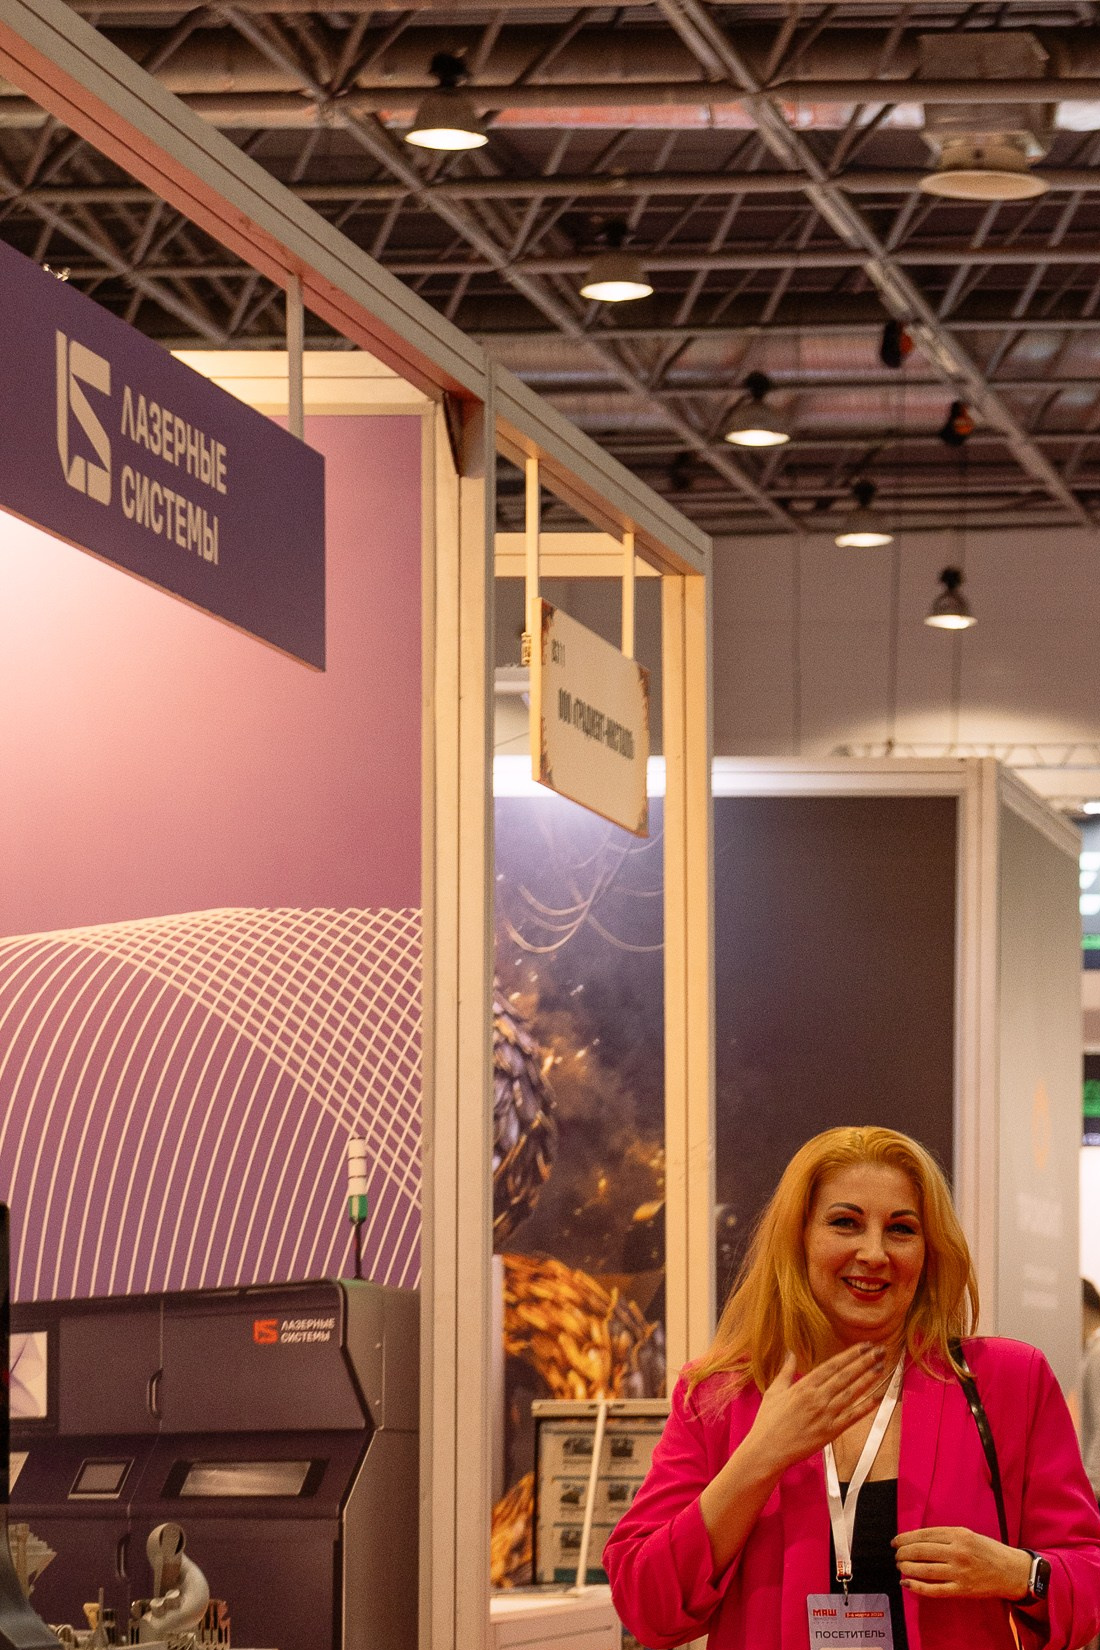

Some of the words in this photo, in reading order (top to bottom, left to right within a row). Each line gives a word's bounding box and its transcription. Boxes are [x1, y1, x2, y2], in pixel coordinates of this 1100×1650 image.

[121, 384, 227, 494] ЛАЗЕРНЫЕ
[121, 465, 219, 565] СИСТЕМЫ
[281, 1318, 335, 1331] ЛАЗЕРНЫЕ
[281, 1331, 330, 1343] СИСТЕМЫ
[813, 1609, 837, 1617] МАШ
[815, 1630, 886, 1639] ПОСЕТИТЕЛЬ
